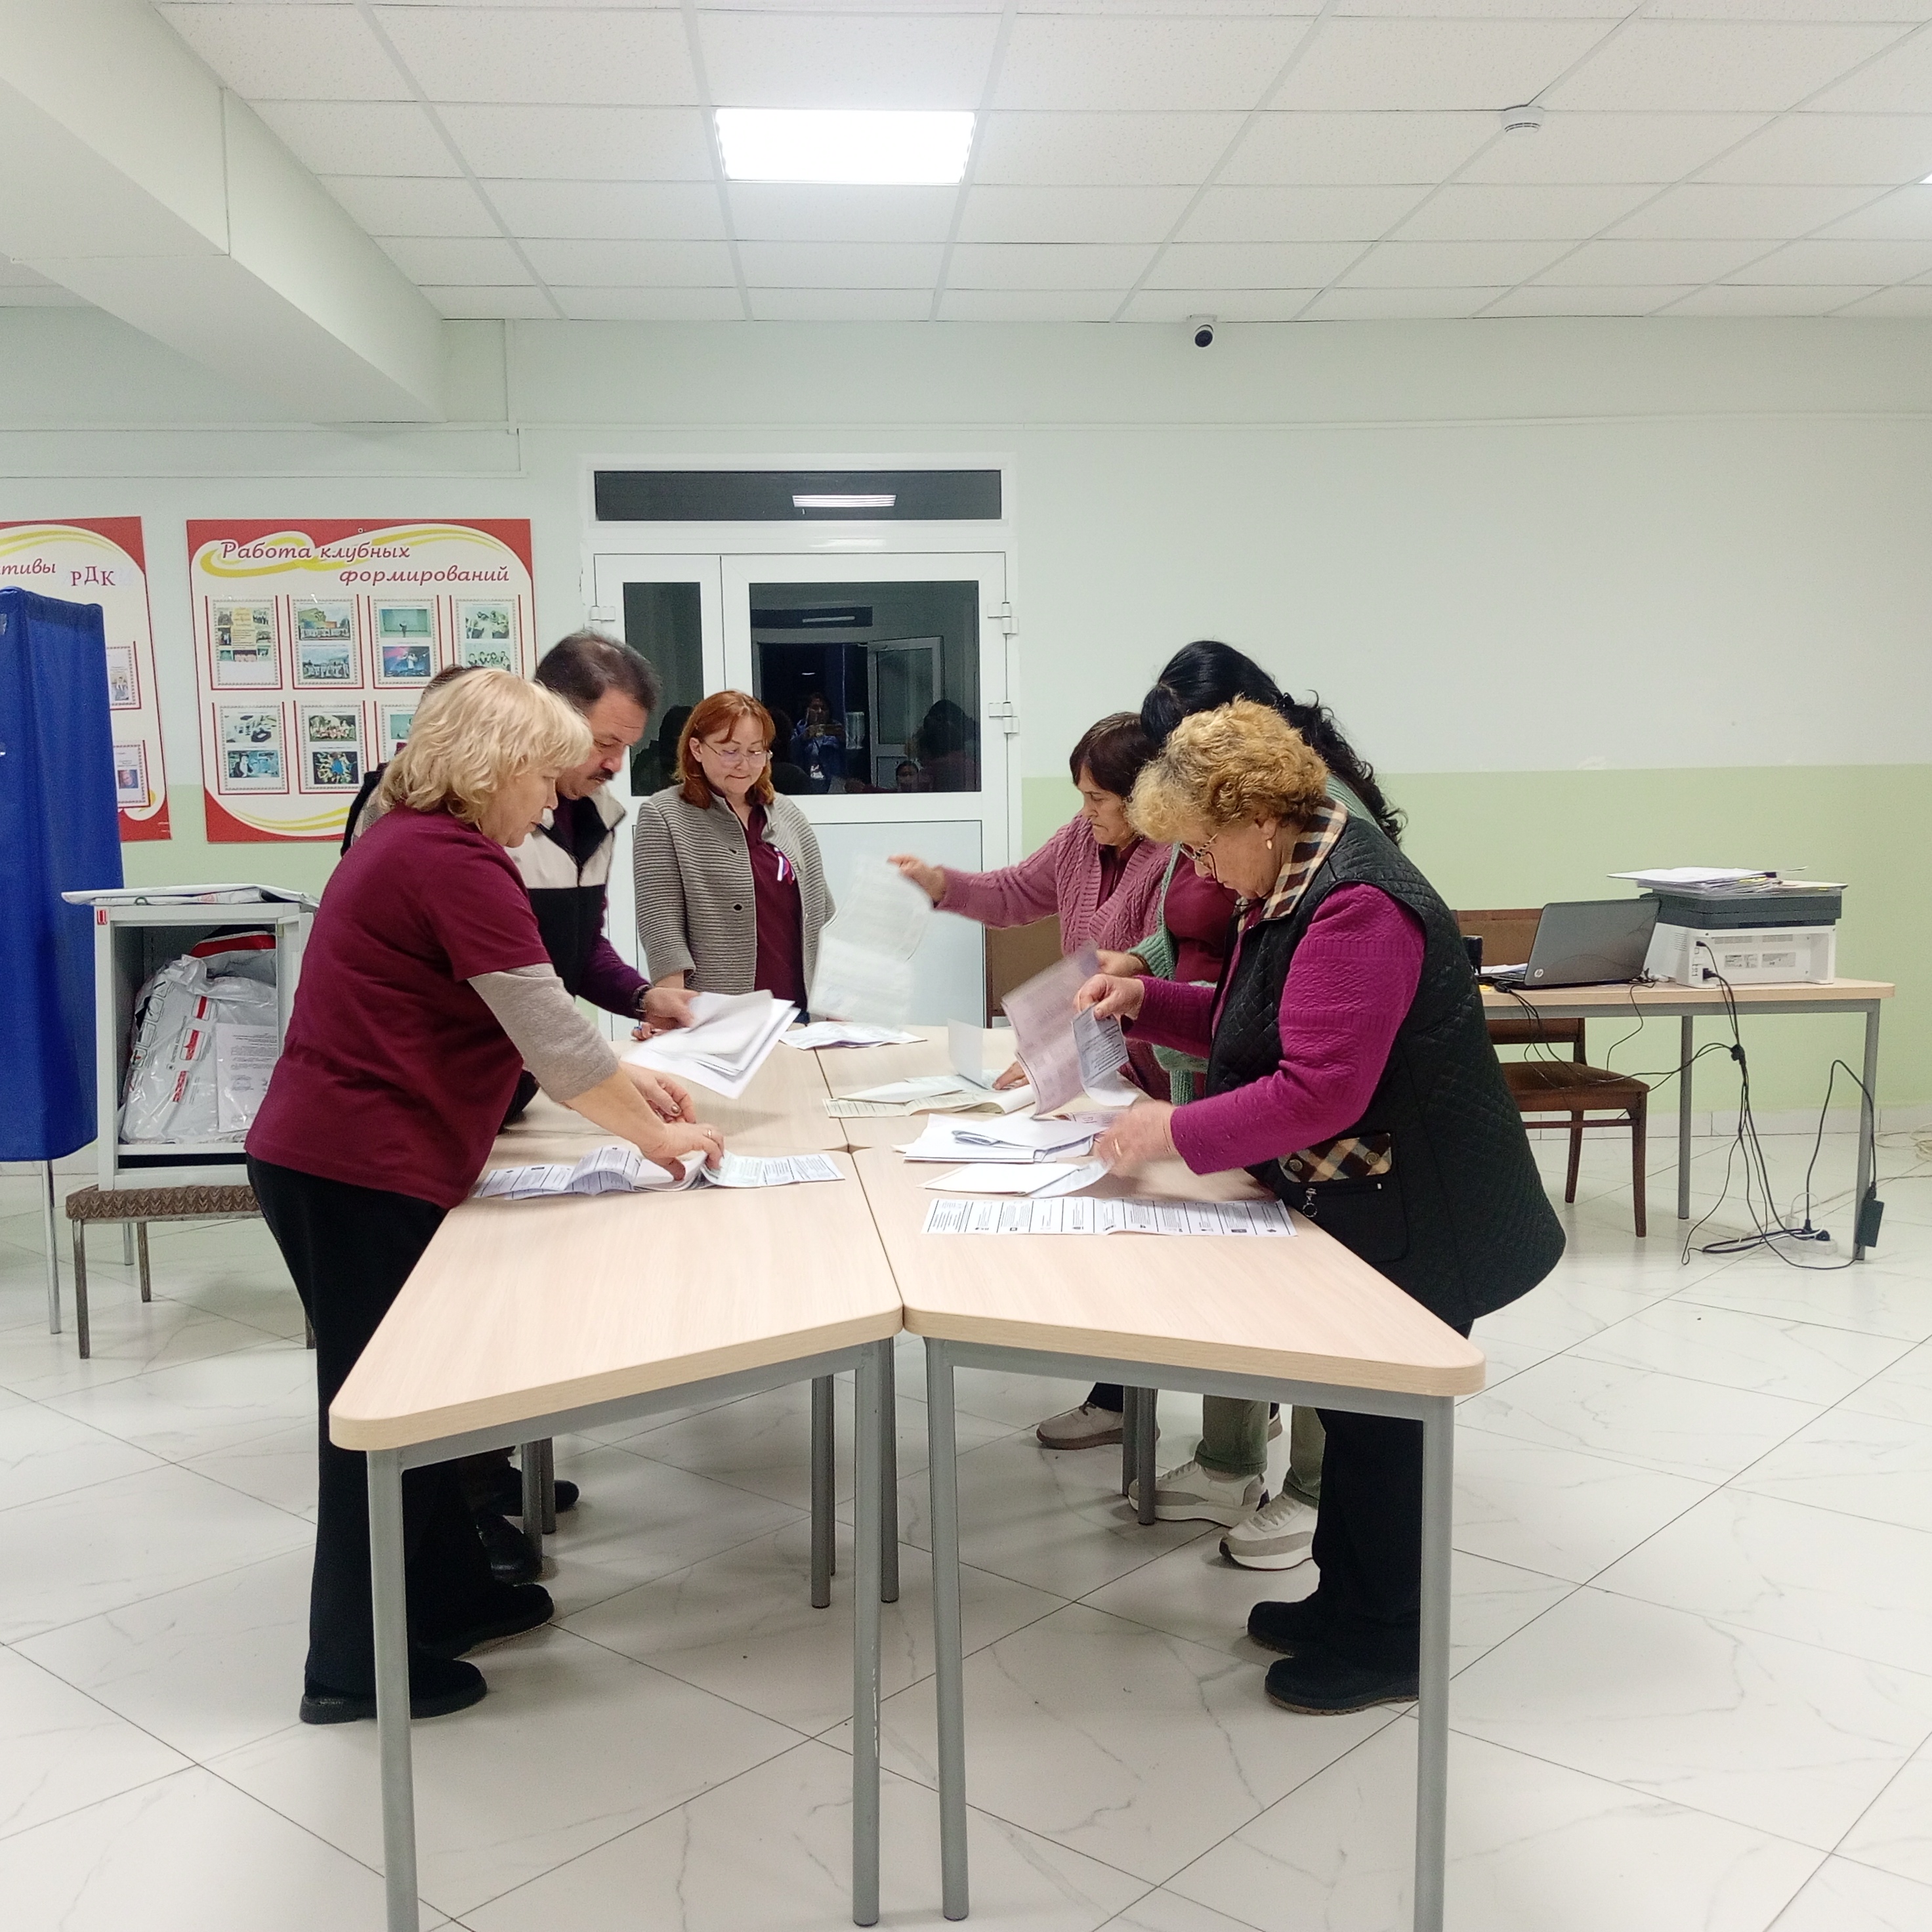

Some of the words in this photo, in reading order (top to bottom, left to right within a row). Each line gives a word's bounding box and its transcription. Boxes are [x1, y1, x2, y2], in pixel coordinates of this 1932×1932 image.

[220, 541, 311, 558] Работа
[320, 541, 410, 562] клубных
[0, 558, 56, 575] тивы
[70, 566, 116, 587] РДК
[339, 564, 509, 586] формирований
